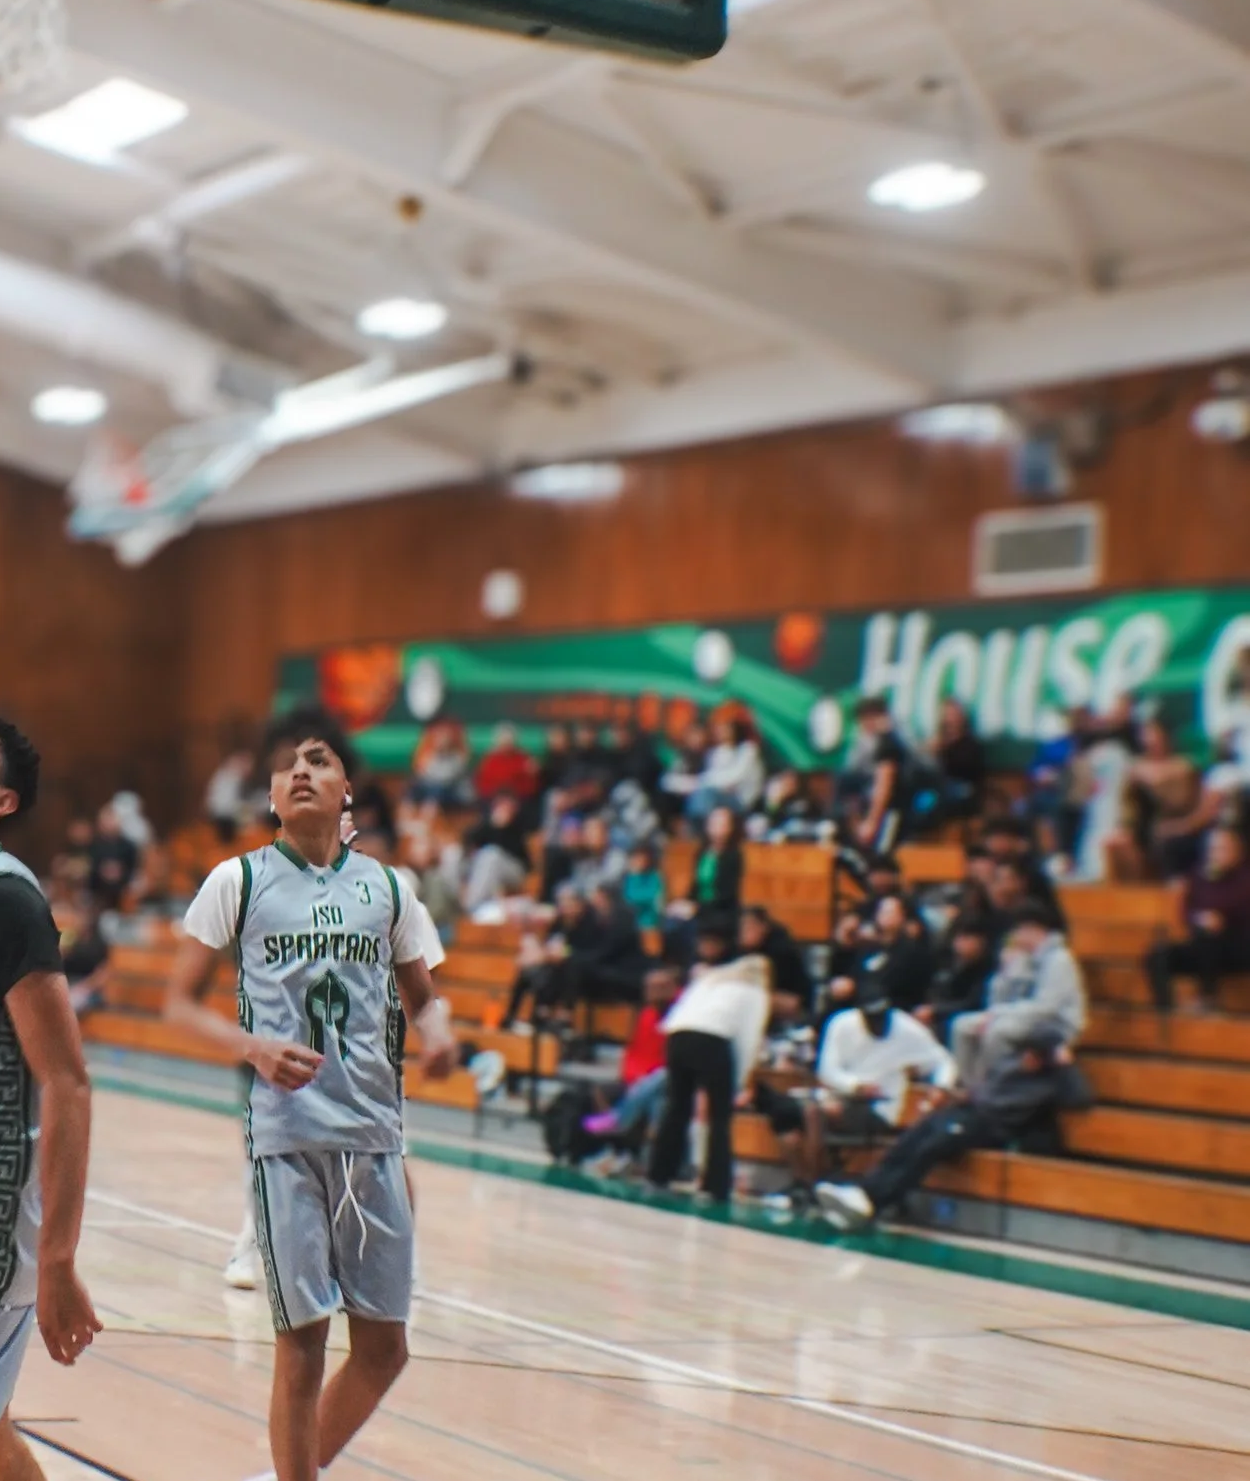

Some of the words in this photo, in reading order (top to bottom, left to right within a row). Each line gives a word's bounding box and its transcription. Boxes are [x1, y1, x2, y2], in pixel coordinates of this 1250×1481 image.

[355, 879, 372, 906] 3
[311, 904, 345, 928] ISO
[263, 931, 381, 966] SPARTANS
